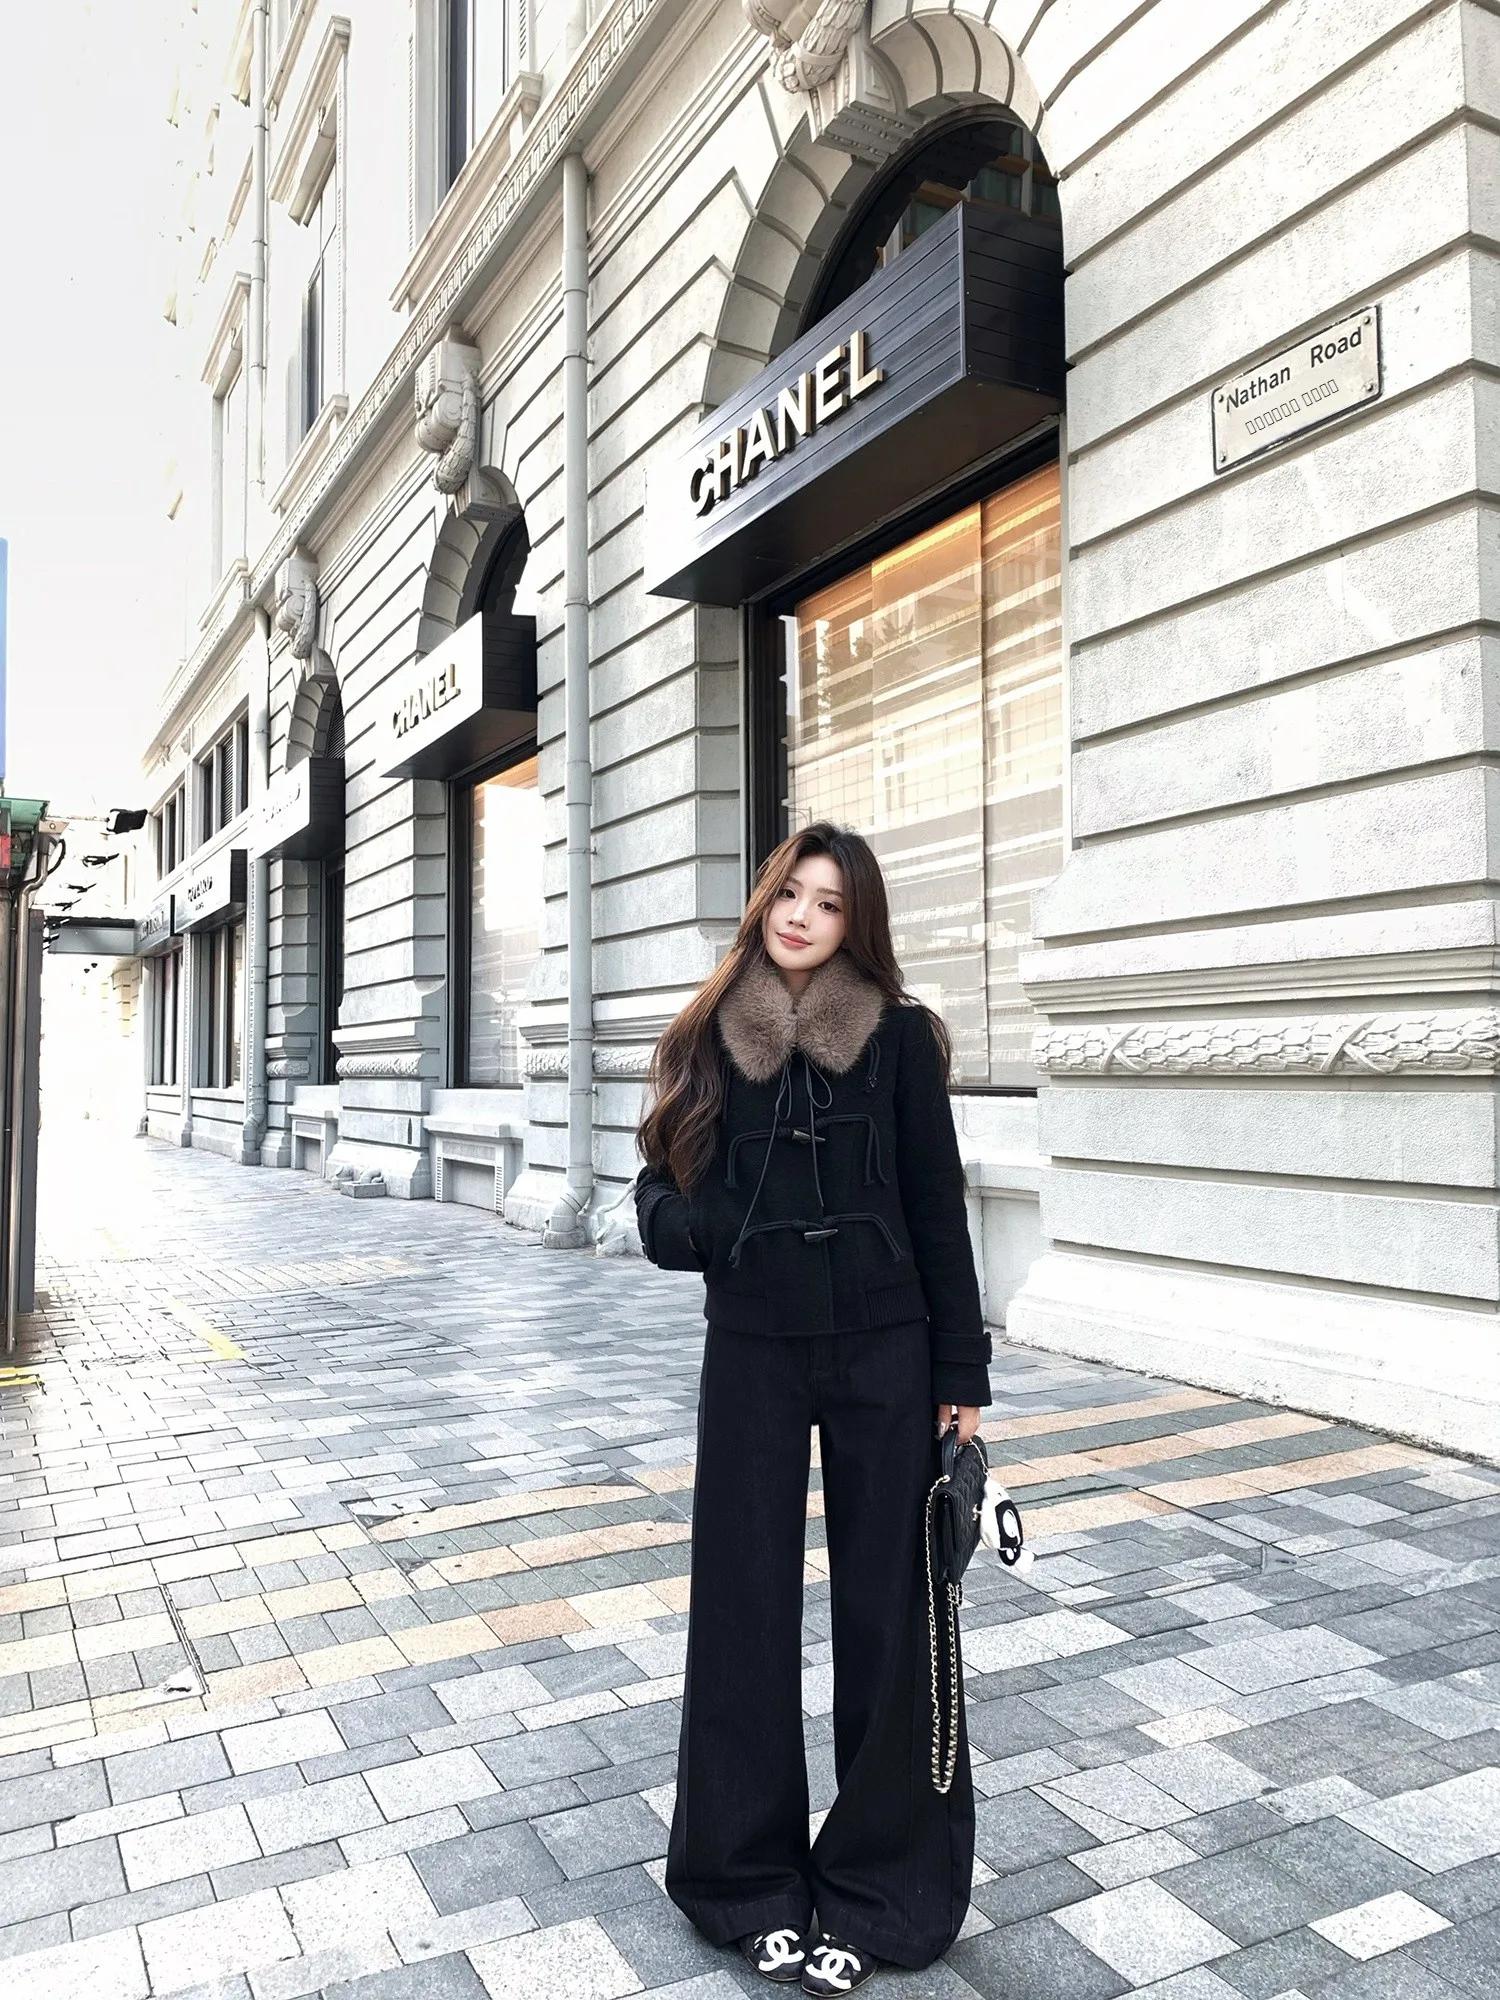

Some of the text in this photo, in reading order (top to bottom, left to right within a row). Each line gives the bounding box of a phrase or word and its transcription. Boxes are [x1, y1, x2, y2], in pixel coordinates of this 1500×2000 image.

[1226, 366, 1291, 413] Nathan
[1310, 326, 1362, 368] Road
[690, 330, 884, 517] CHANEL
[393, 663, 461, 739] CHANEL
